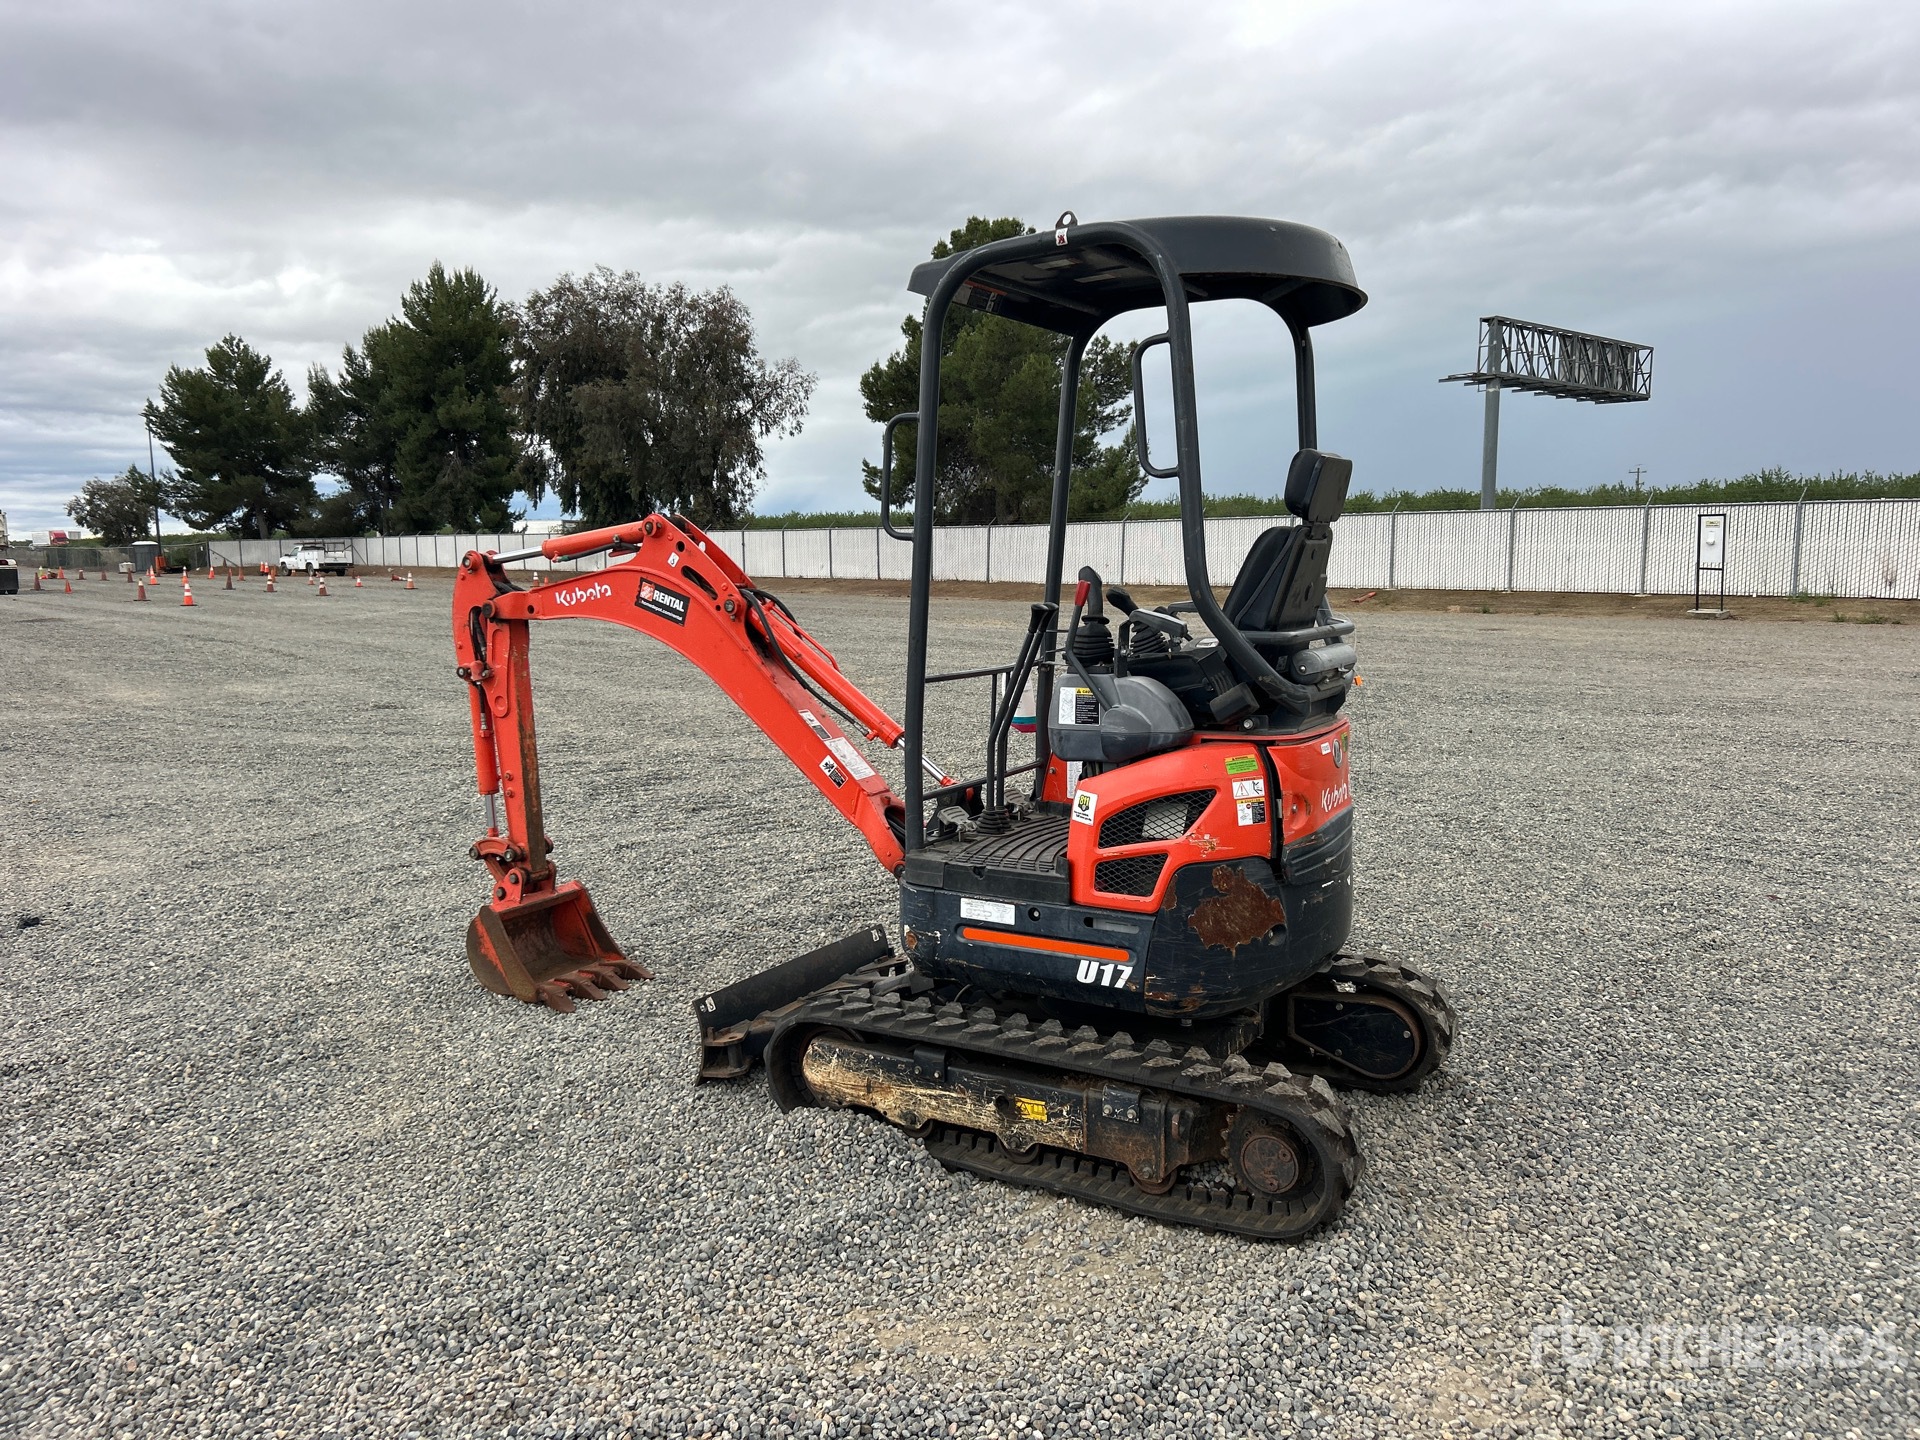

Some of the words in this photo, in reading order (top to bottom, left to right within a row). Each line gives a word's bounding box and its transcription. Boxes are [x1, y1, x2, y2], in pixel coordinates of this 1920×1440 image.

[555, 582, 612, 607] Kubota
[653, 590, 684, 612] RENTAL
[1076, 960, 1133, 988] U17
